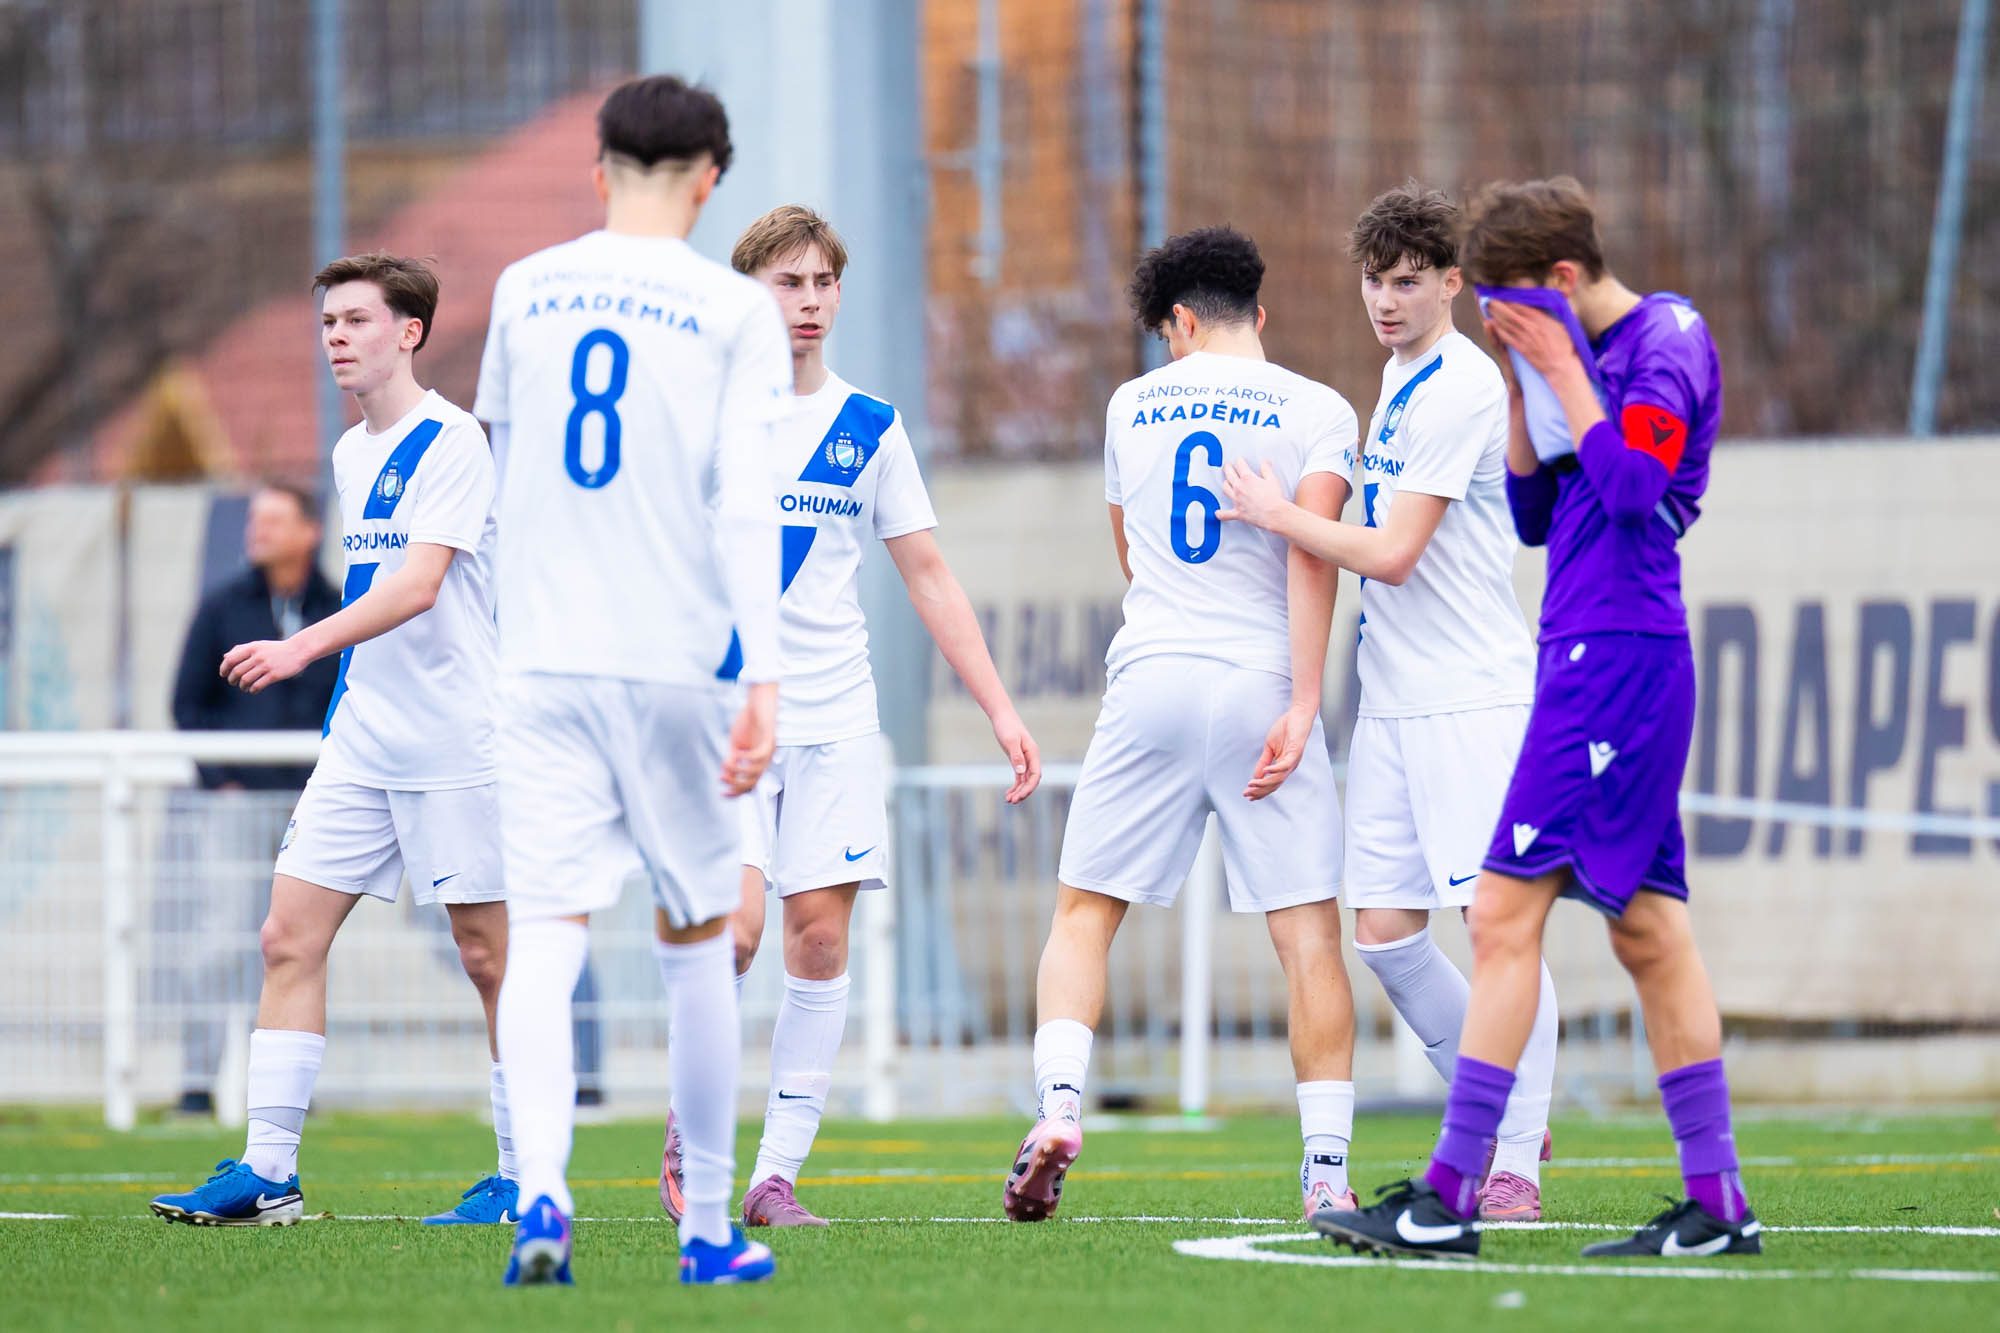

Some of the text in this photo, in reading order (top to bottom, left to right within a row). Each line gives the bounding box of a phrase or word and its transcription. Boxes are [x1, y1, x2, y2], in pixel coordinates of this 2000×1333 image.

[565, 329, 629, 489] 8
[1132, 401, 1281, 428] AKADÉMIA
[1137, 385, 1288, 407] SÁNDOR KÁROLY
[776, 494, 863, 517] OHUMAN
[1171, 431, 1222, 563] 6
[1695, 599, 2000, 860] DAPE
